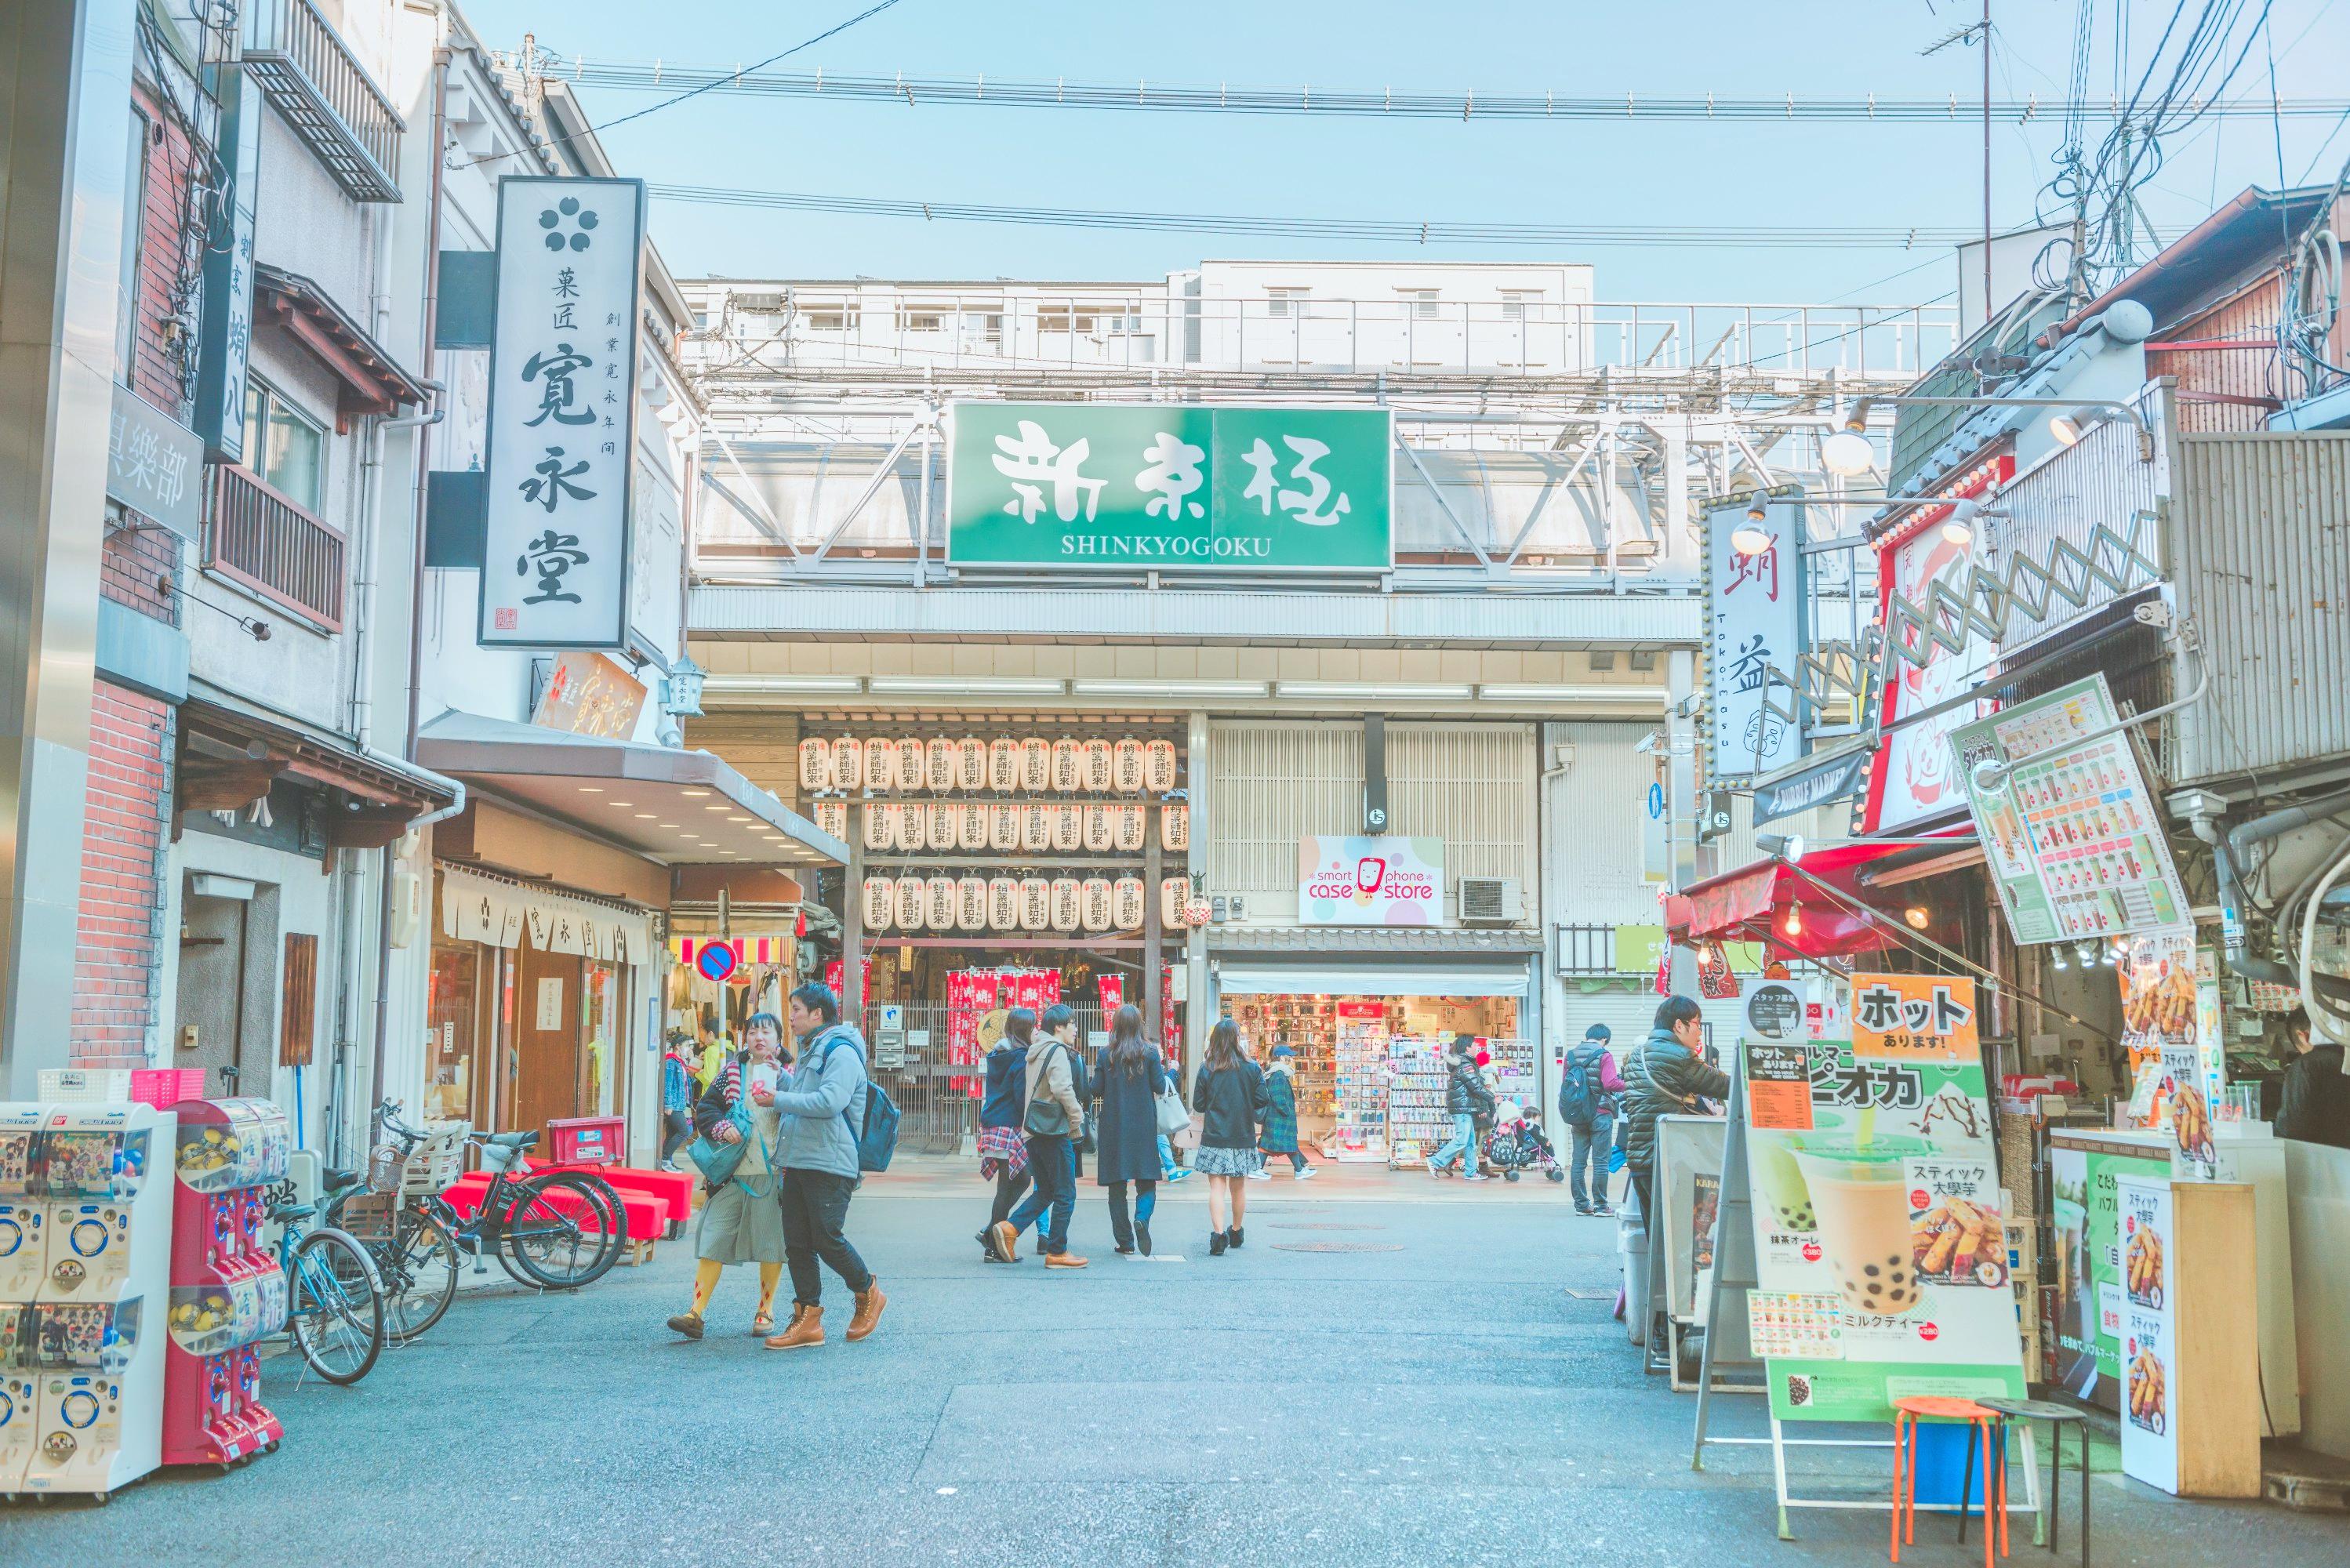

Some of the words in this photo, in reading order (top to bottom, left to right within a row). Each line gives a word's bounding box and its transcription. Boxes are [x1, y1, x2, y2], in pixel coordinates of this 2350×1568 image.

[551, 267, 581, 331] 菓匠
[601, 312, 620, 456] 創業寛永年間
[516, 343, 598, 605] 寛永堂
[992, 420, 1350, 526] 新京極
[1061, 535, 1272, 557] SHINKYOGOKU
[1318, 871, 1353, 880] smart
[1386, 870, 1424, 884] phone
[1309, 884, 1353, 898] case
[1385, 882, 1433, 898] store
[1861, 988, 1966, 1031] ホット
[1883, 1034, 1946, 1049] あります!
[1913, 1166, 1985, 1180] スティック
[1933, 1181, 1976, 1196] 大學芋
[1845, 1315, 1926, 1329] ミルクティー
